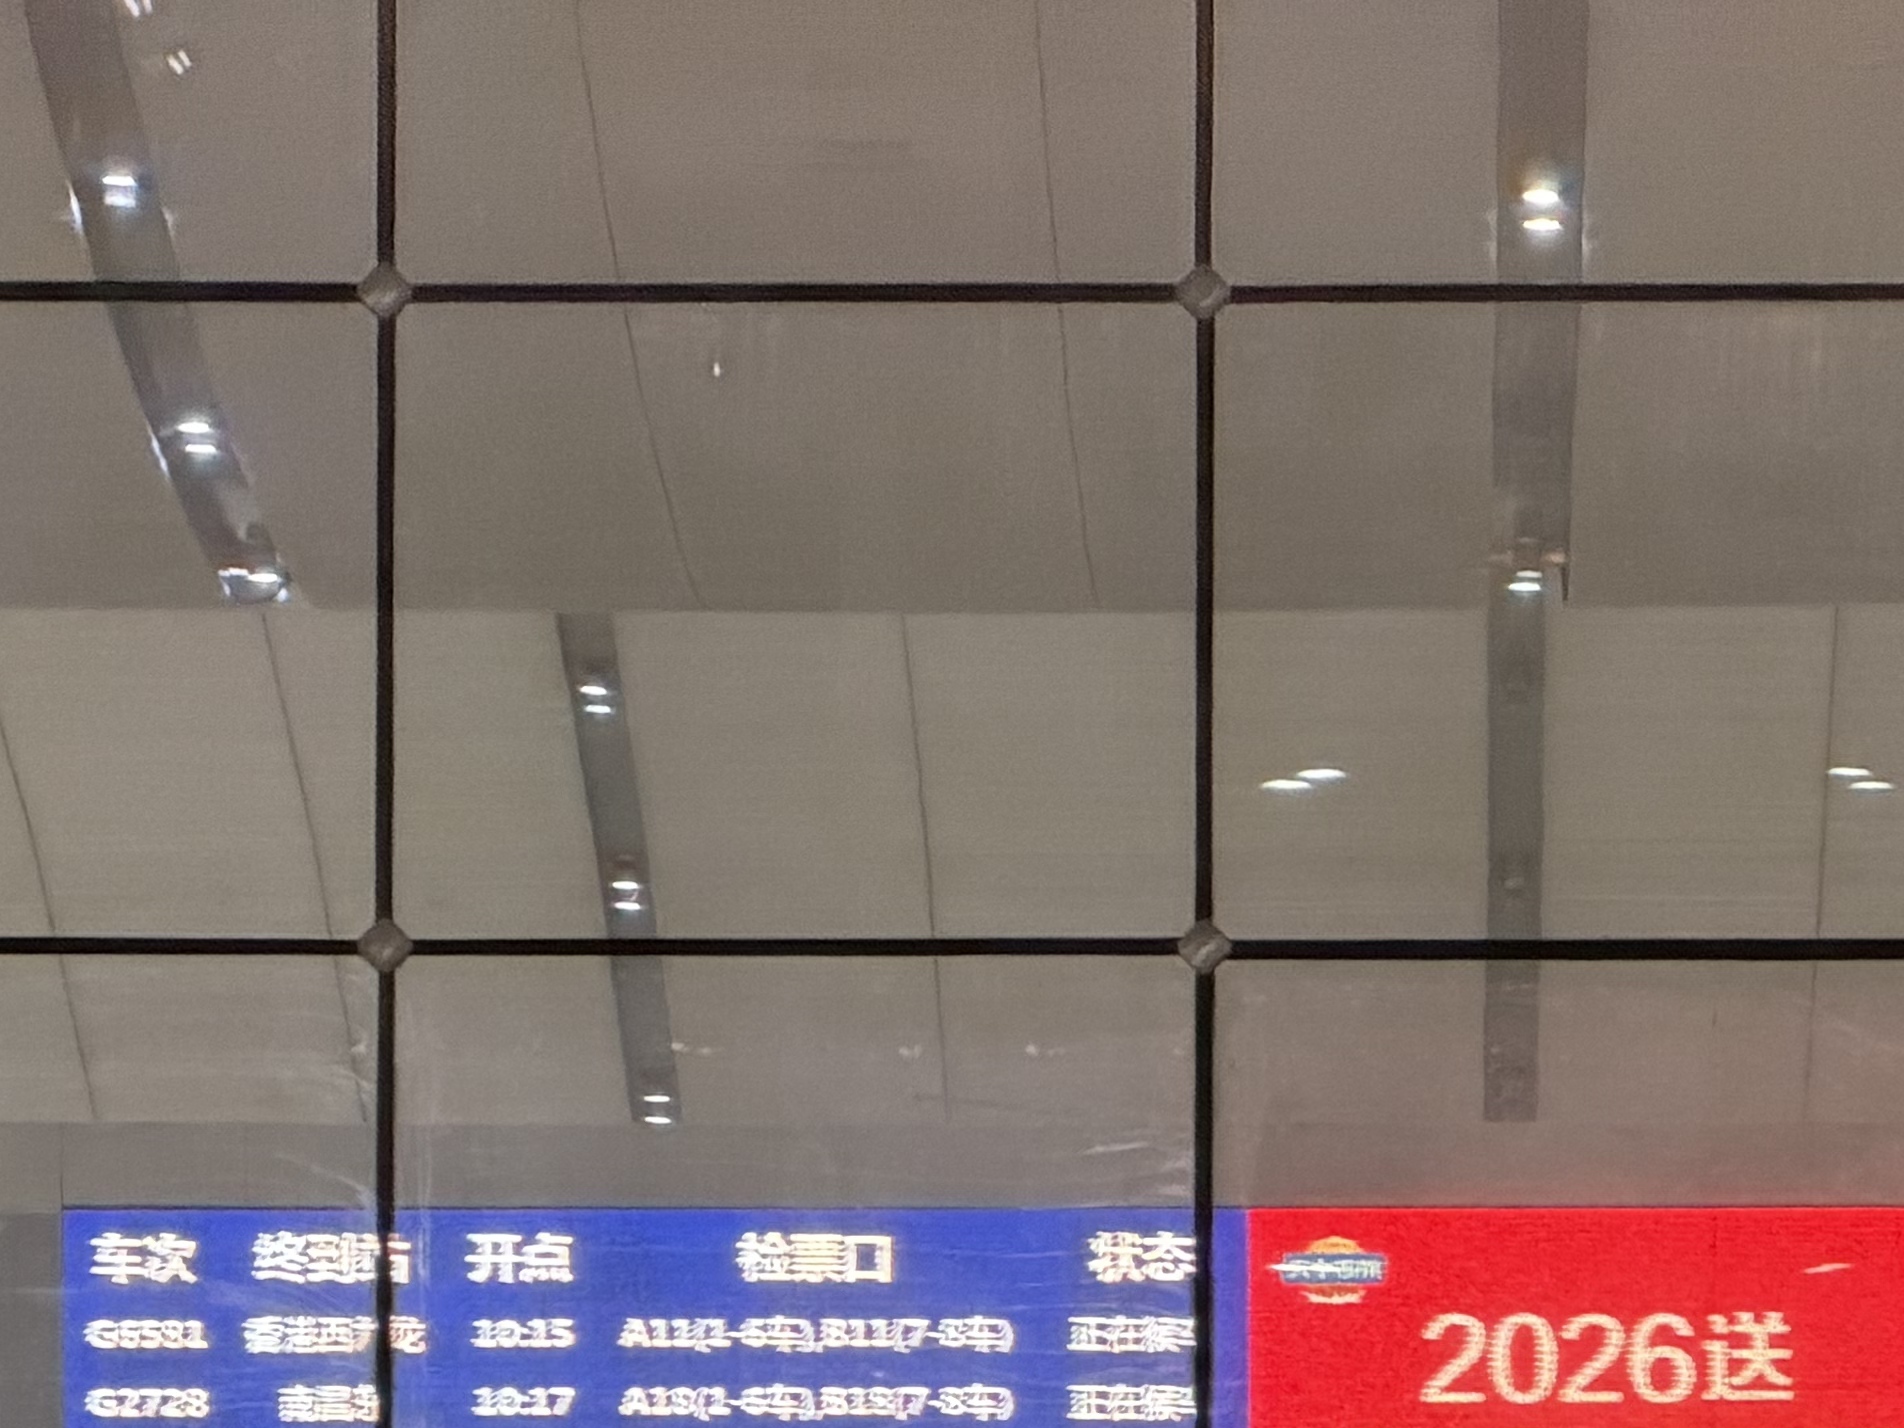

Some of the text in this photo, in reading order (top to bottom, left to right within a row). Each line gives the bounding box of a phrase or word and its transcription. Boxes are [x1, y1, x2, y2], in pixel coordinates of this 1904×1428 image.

[91, 1232, 1194, 1285] 车次 终到站 开点 检票口 状态
[1424, 1314, 1793, 1404] 2026送
